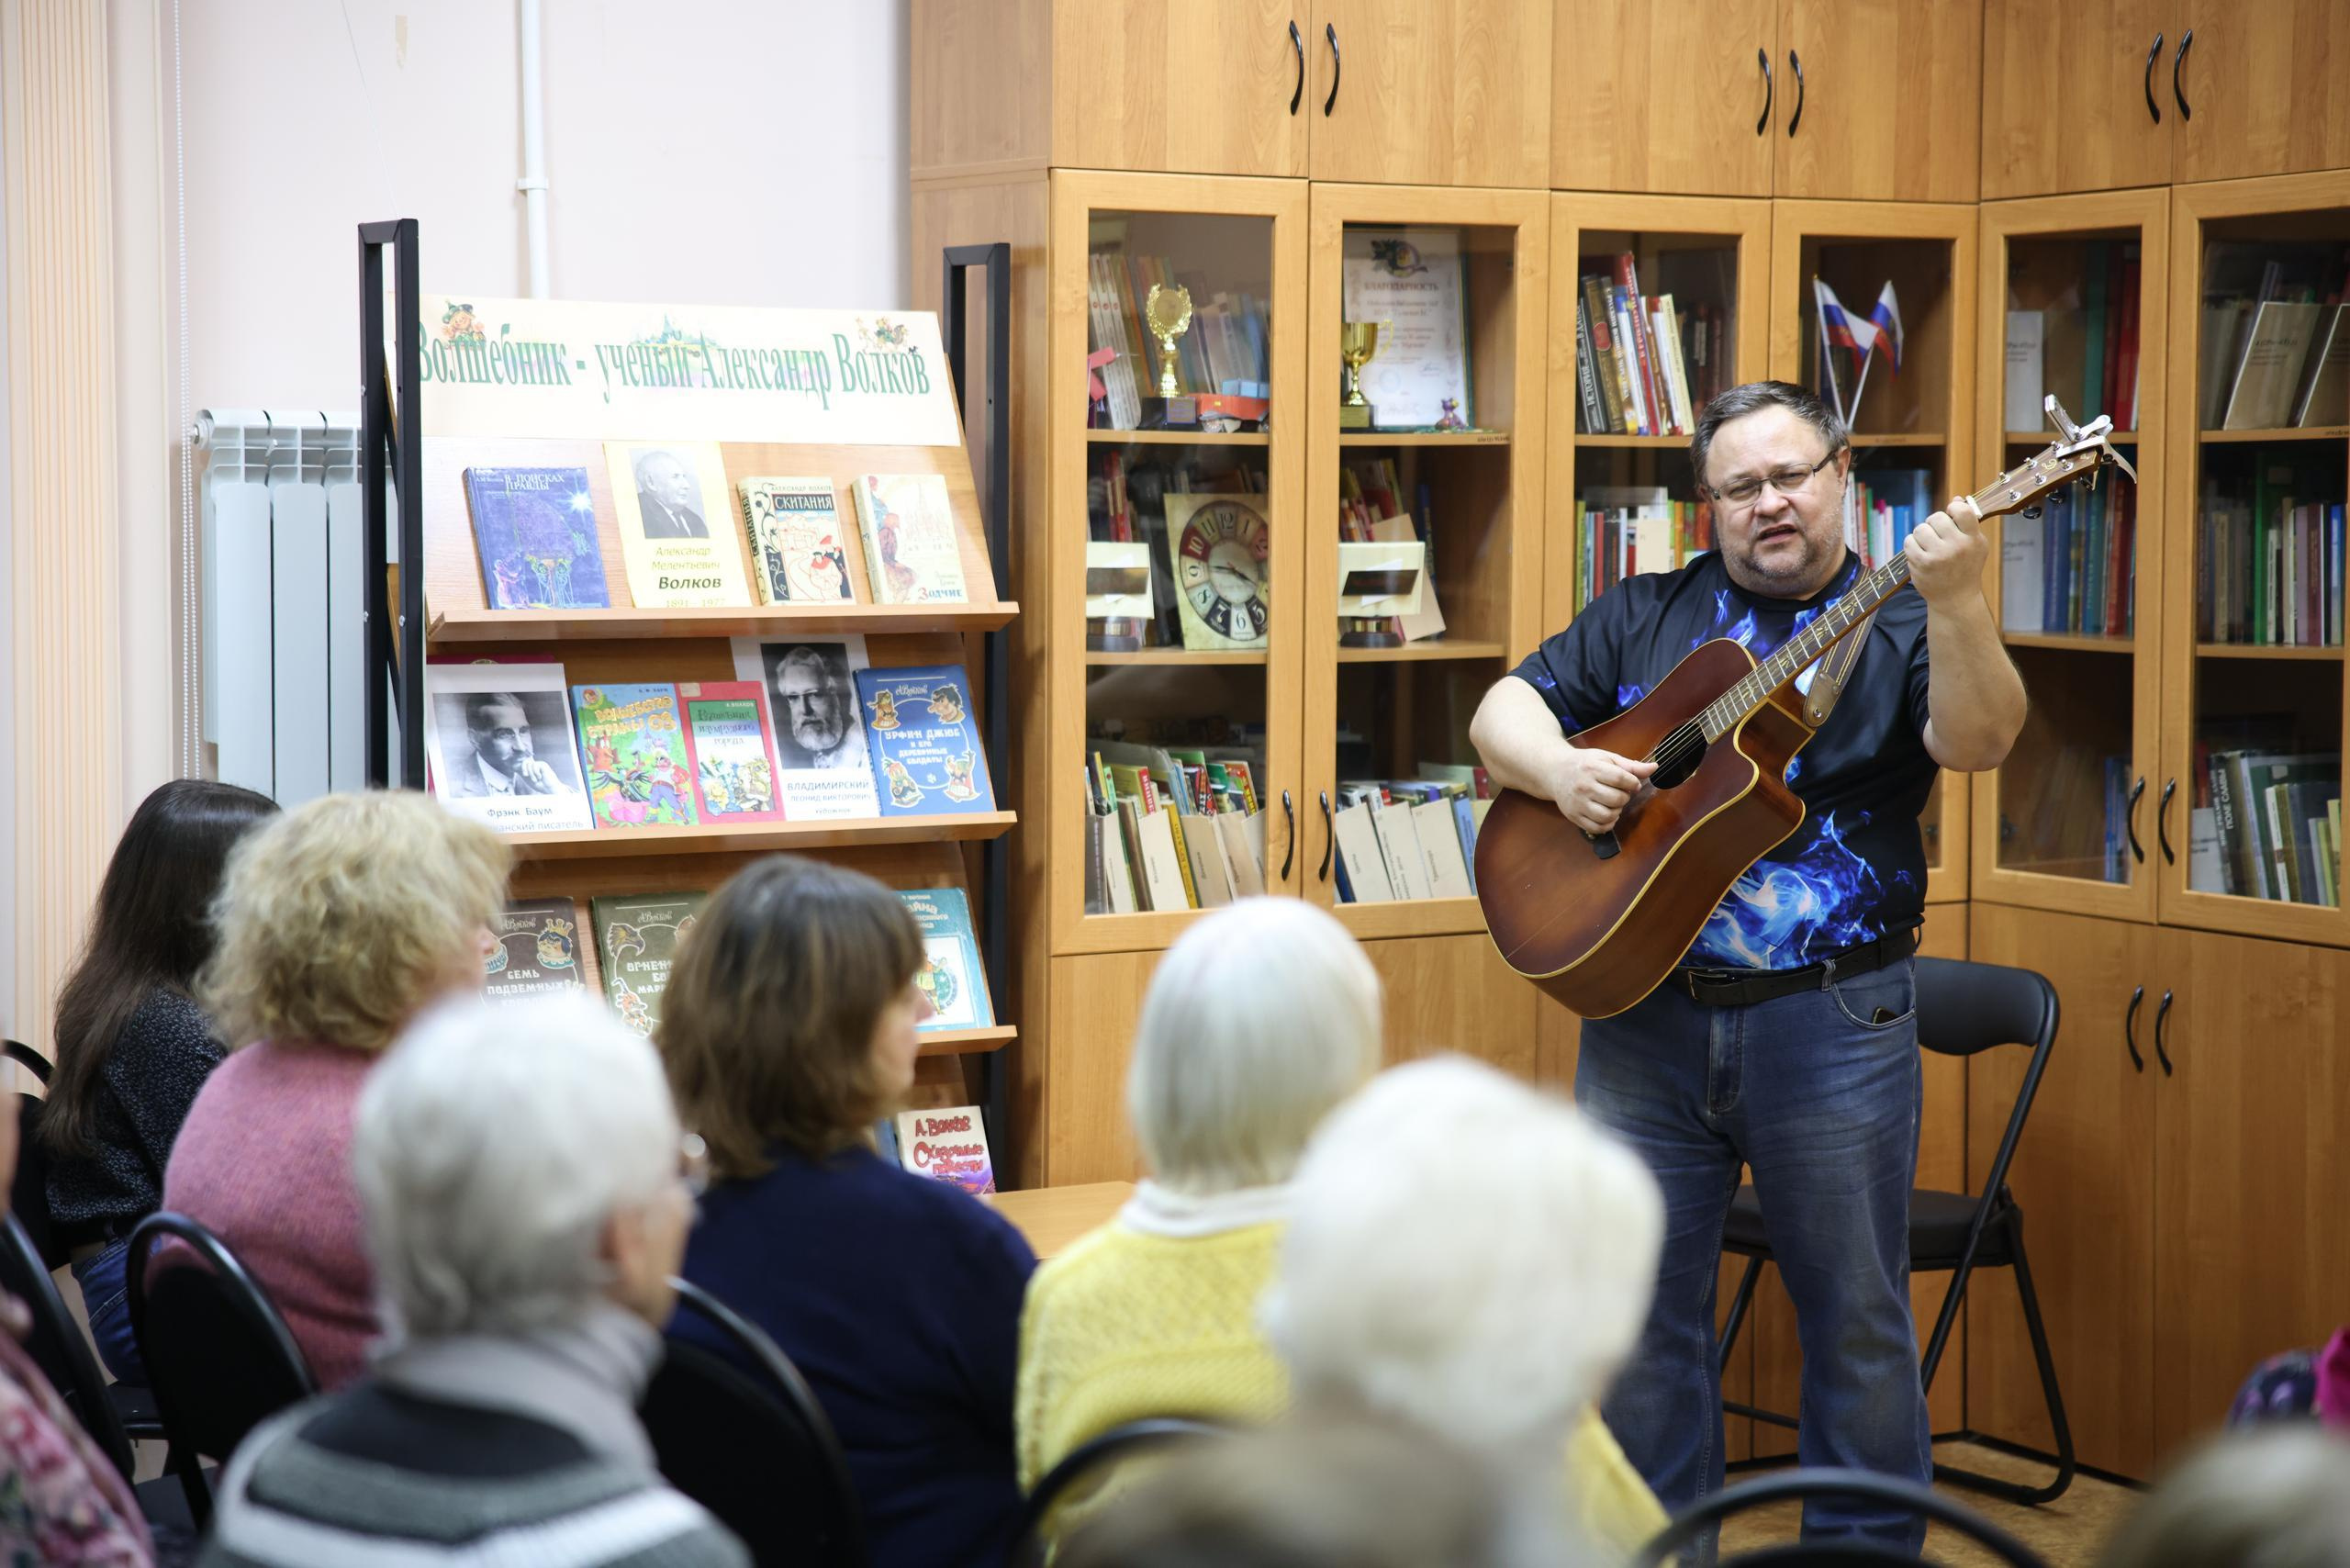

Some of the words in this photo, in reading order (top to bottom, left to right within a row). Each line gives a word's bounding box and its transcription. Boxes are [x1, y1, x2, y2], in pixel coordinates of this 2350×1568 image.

[699, 331, 832, 410] Александр
[833, 332, 931, 395] Волков
[775, 497, 833, 510] СКИТАНИЯ
[1220, 513, 1234, 530] 12
[655, 546, 711, 557] Александр
[1189, 536, 1205, 555] 10
[652, 560, 721, 571] Мелентьевич
[658, 576, 722, 590] Волков
[1216, 604, 1227, 623] 7
[1236, 610, 1247, 630] 6
[1253, 606, 1266, 625] 5
[648, 711, 677, 732] ОЗ
[787, 780, 869, 791] ВЛАДИМИРСКИЙ
[790, 794, 822, 802] ЛЕОНИД
[822, 792, 871, 801] ВИКТОРОВИЧ
[487, 808, 520, 820] Фрэнк
[525, 806, 553, 818] Баум
[498, 821, 535, 832] анский
[538, 820, 584, 831] писатель
[508, 969, 540, 980] СЕМЬ
[487, 981, 565, 996] ПОДЗЕМНЫХ
